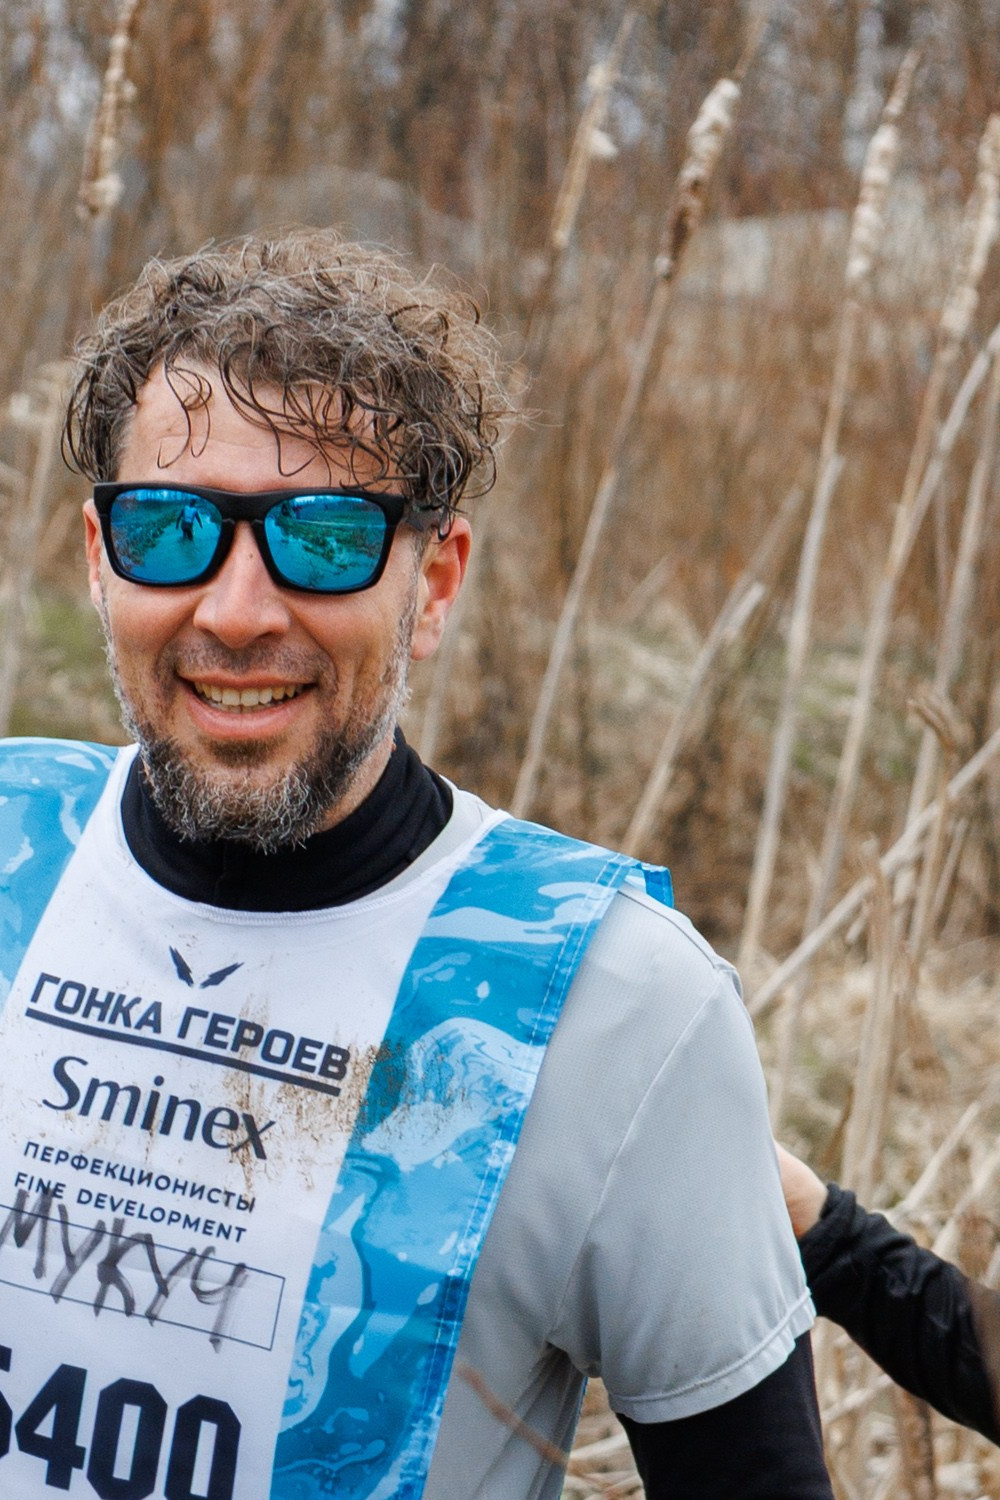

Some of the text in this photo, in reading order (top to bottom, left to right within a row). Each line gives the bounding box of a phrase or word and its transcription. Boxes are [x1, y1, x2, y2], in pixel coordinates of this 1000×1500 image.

[30, 972, 351, 1081] ГОНКА ГЕРОЕВ
[42, 1056, 276, 1160] Sminex
[14, 1172, 247, 1244] FINE DEVELOPMENT
[24, 1141, 256, 1213] ПЕРФЕКЦИОНИСТЫ
